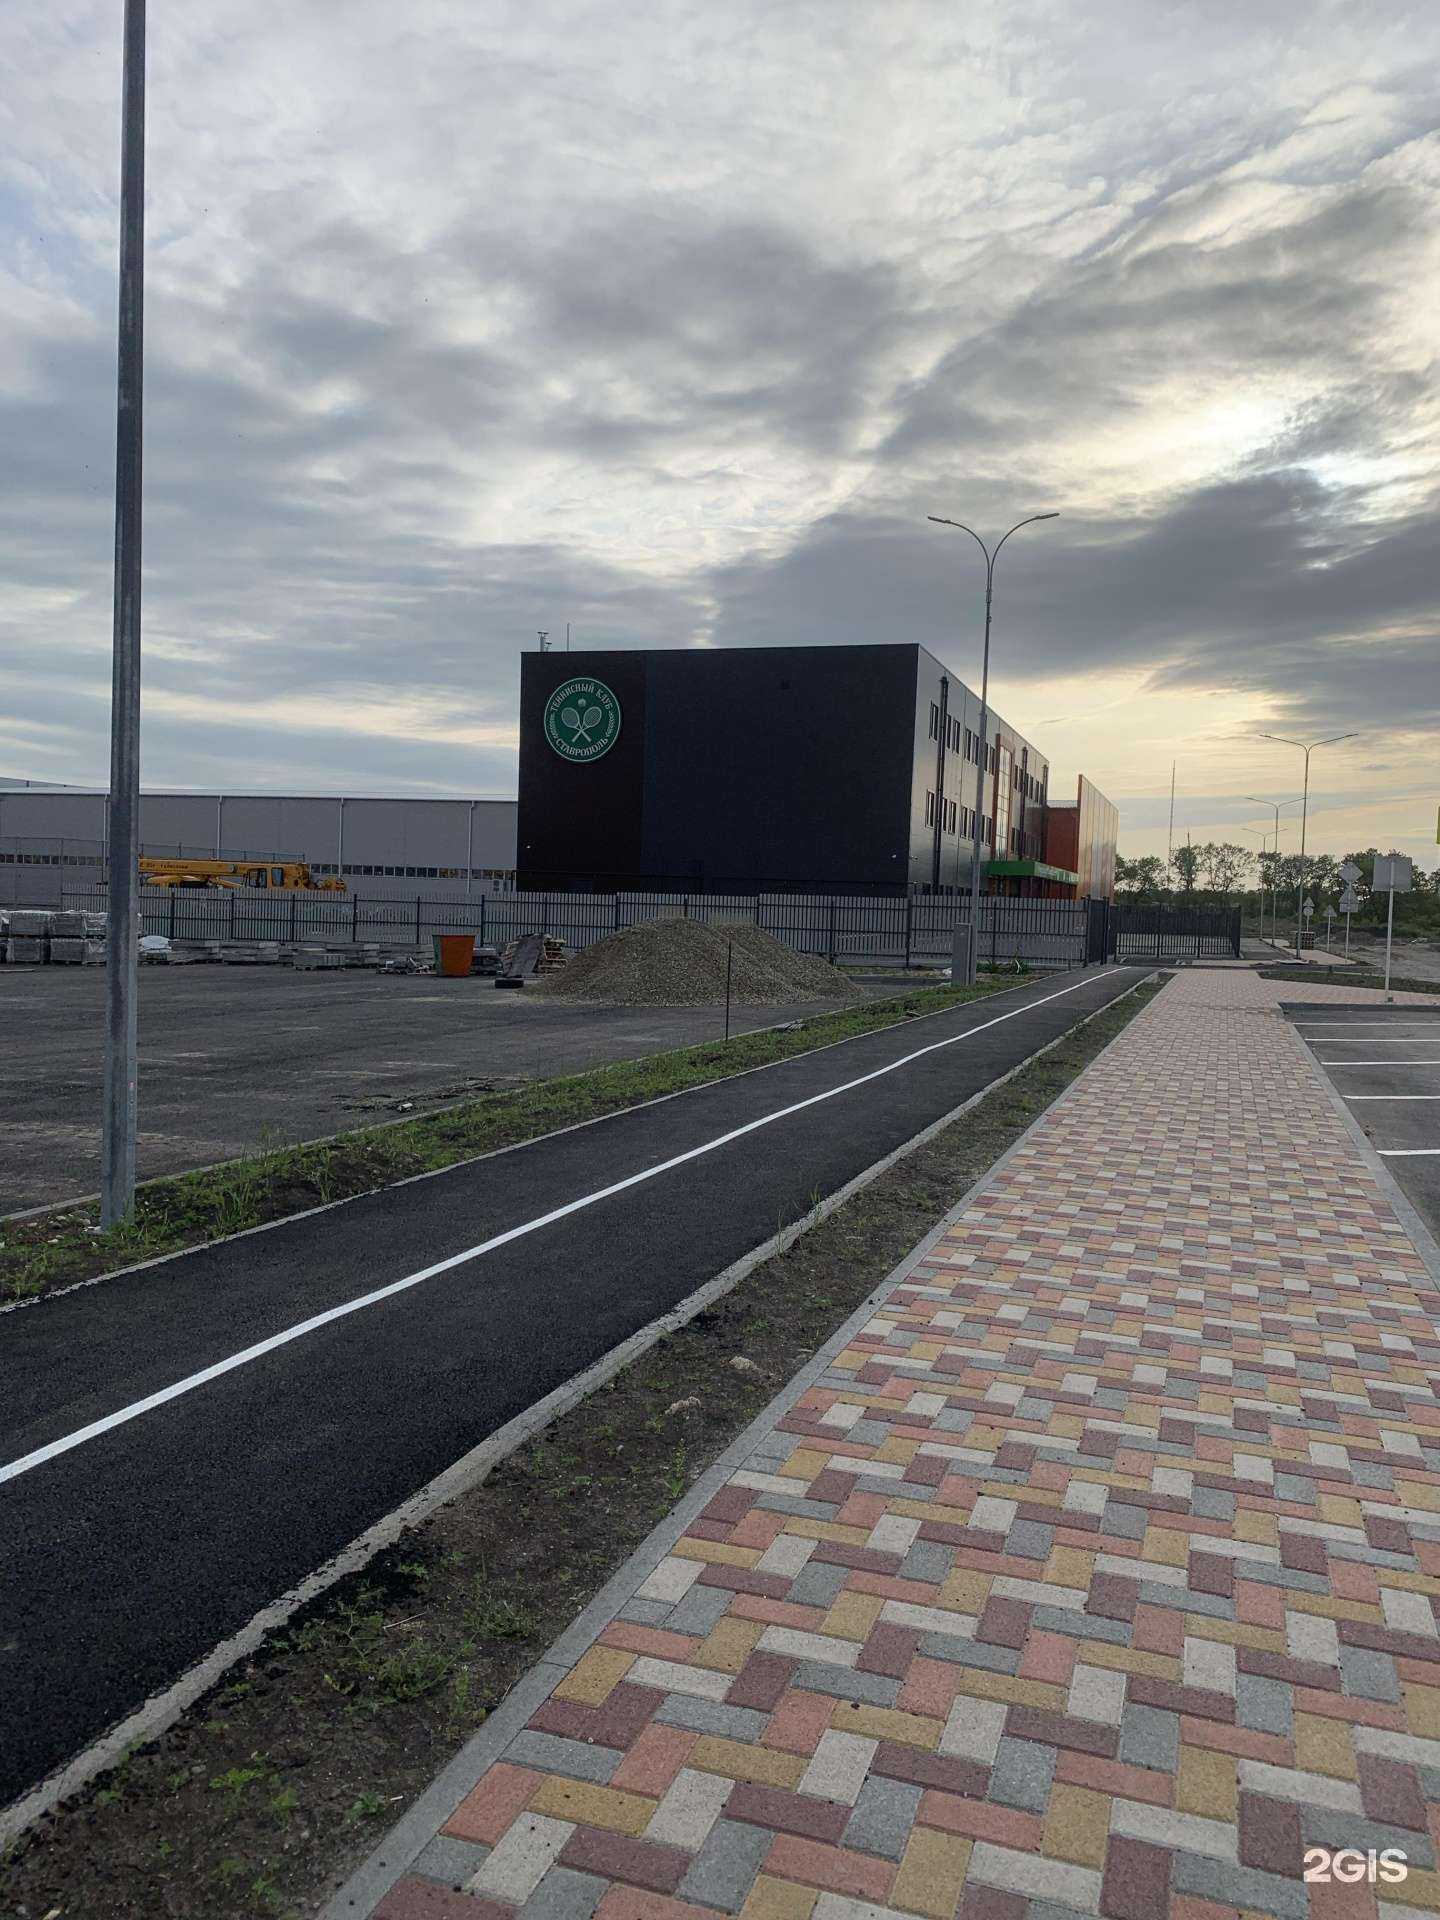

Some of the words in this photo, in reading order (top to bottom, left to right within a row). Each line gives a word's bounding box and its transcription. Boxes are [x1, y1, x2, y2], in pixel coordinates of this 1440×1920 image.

[550, 683, 594, 711] ТЕННИСНЫЙ
[595, 688, 613, 710] КЛУБ
[556, 738, 608, 756] СТАВРОПОЛЬ
